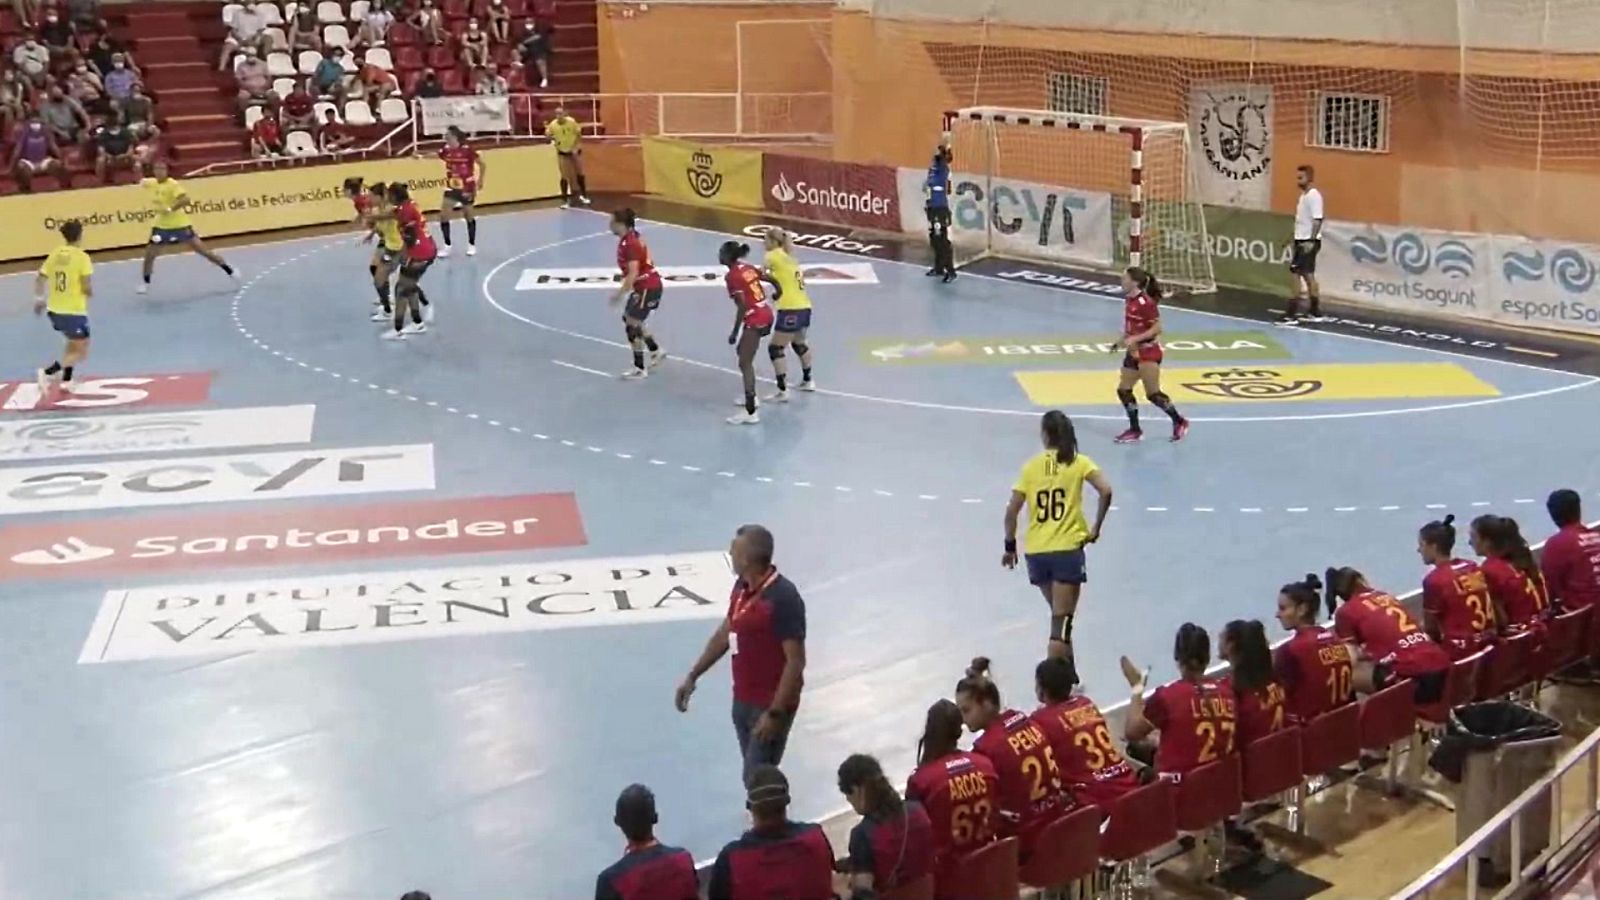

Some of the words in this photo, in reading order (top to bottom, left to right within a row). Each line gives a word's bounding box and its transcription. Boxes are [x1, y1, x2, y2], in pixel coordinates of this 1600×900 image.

[44, 209, 113, 230] Opador
[183, 199, 225, 214] Oficial
[228, 198, 245, 210] de
[247, 197, 260, 208] la
[262, 187, 333, 206] Federación
[796, 182, 891, 215] Santander
[956, 182, 1087, 246] acyr
[1164, 227, 1293, 264] IBERDROLA
[55, 271, 67, 292] 13
[1501, 300, 1600, 330] esportSa
[982, 340, 1267, 356] IBERDOLA
[1036, 488, 1066, 523] 96
[131, 517, 539, 558] Santander
[610, 563, 697, 581] DE
[1386, 606, 1416, 632] 2
[1327, 665, 1350, 704] 10
[1074, 724, 1121, 770] 39
[1196, 721, 1235, 763] 27
[948, 770, 987, 801] ARCOS
